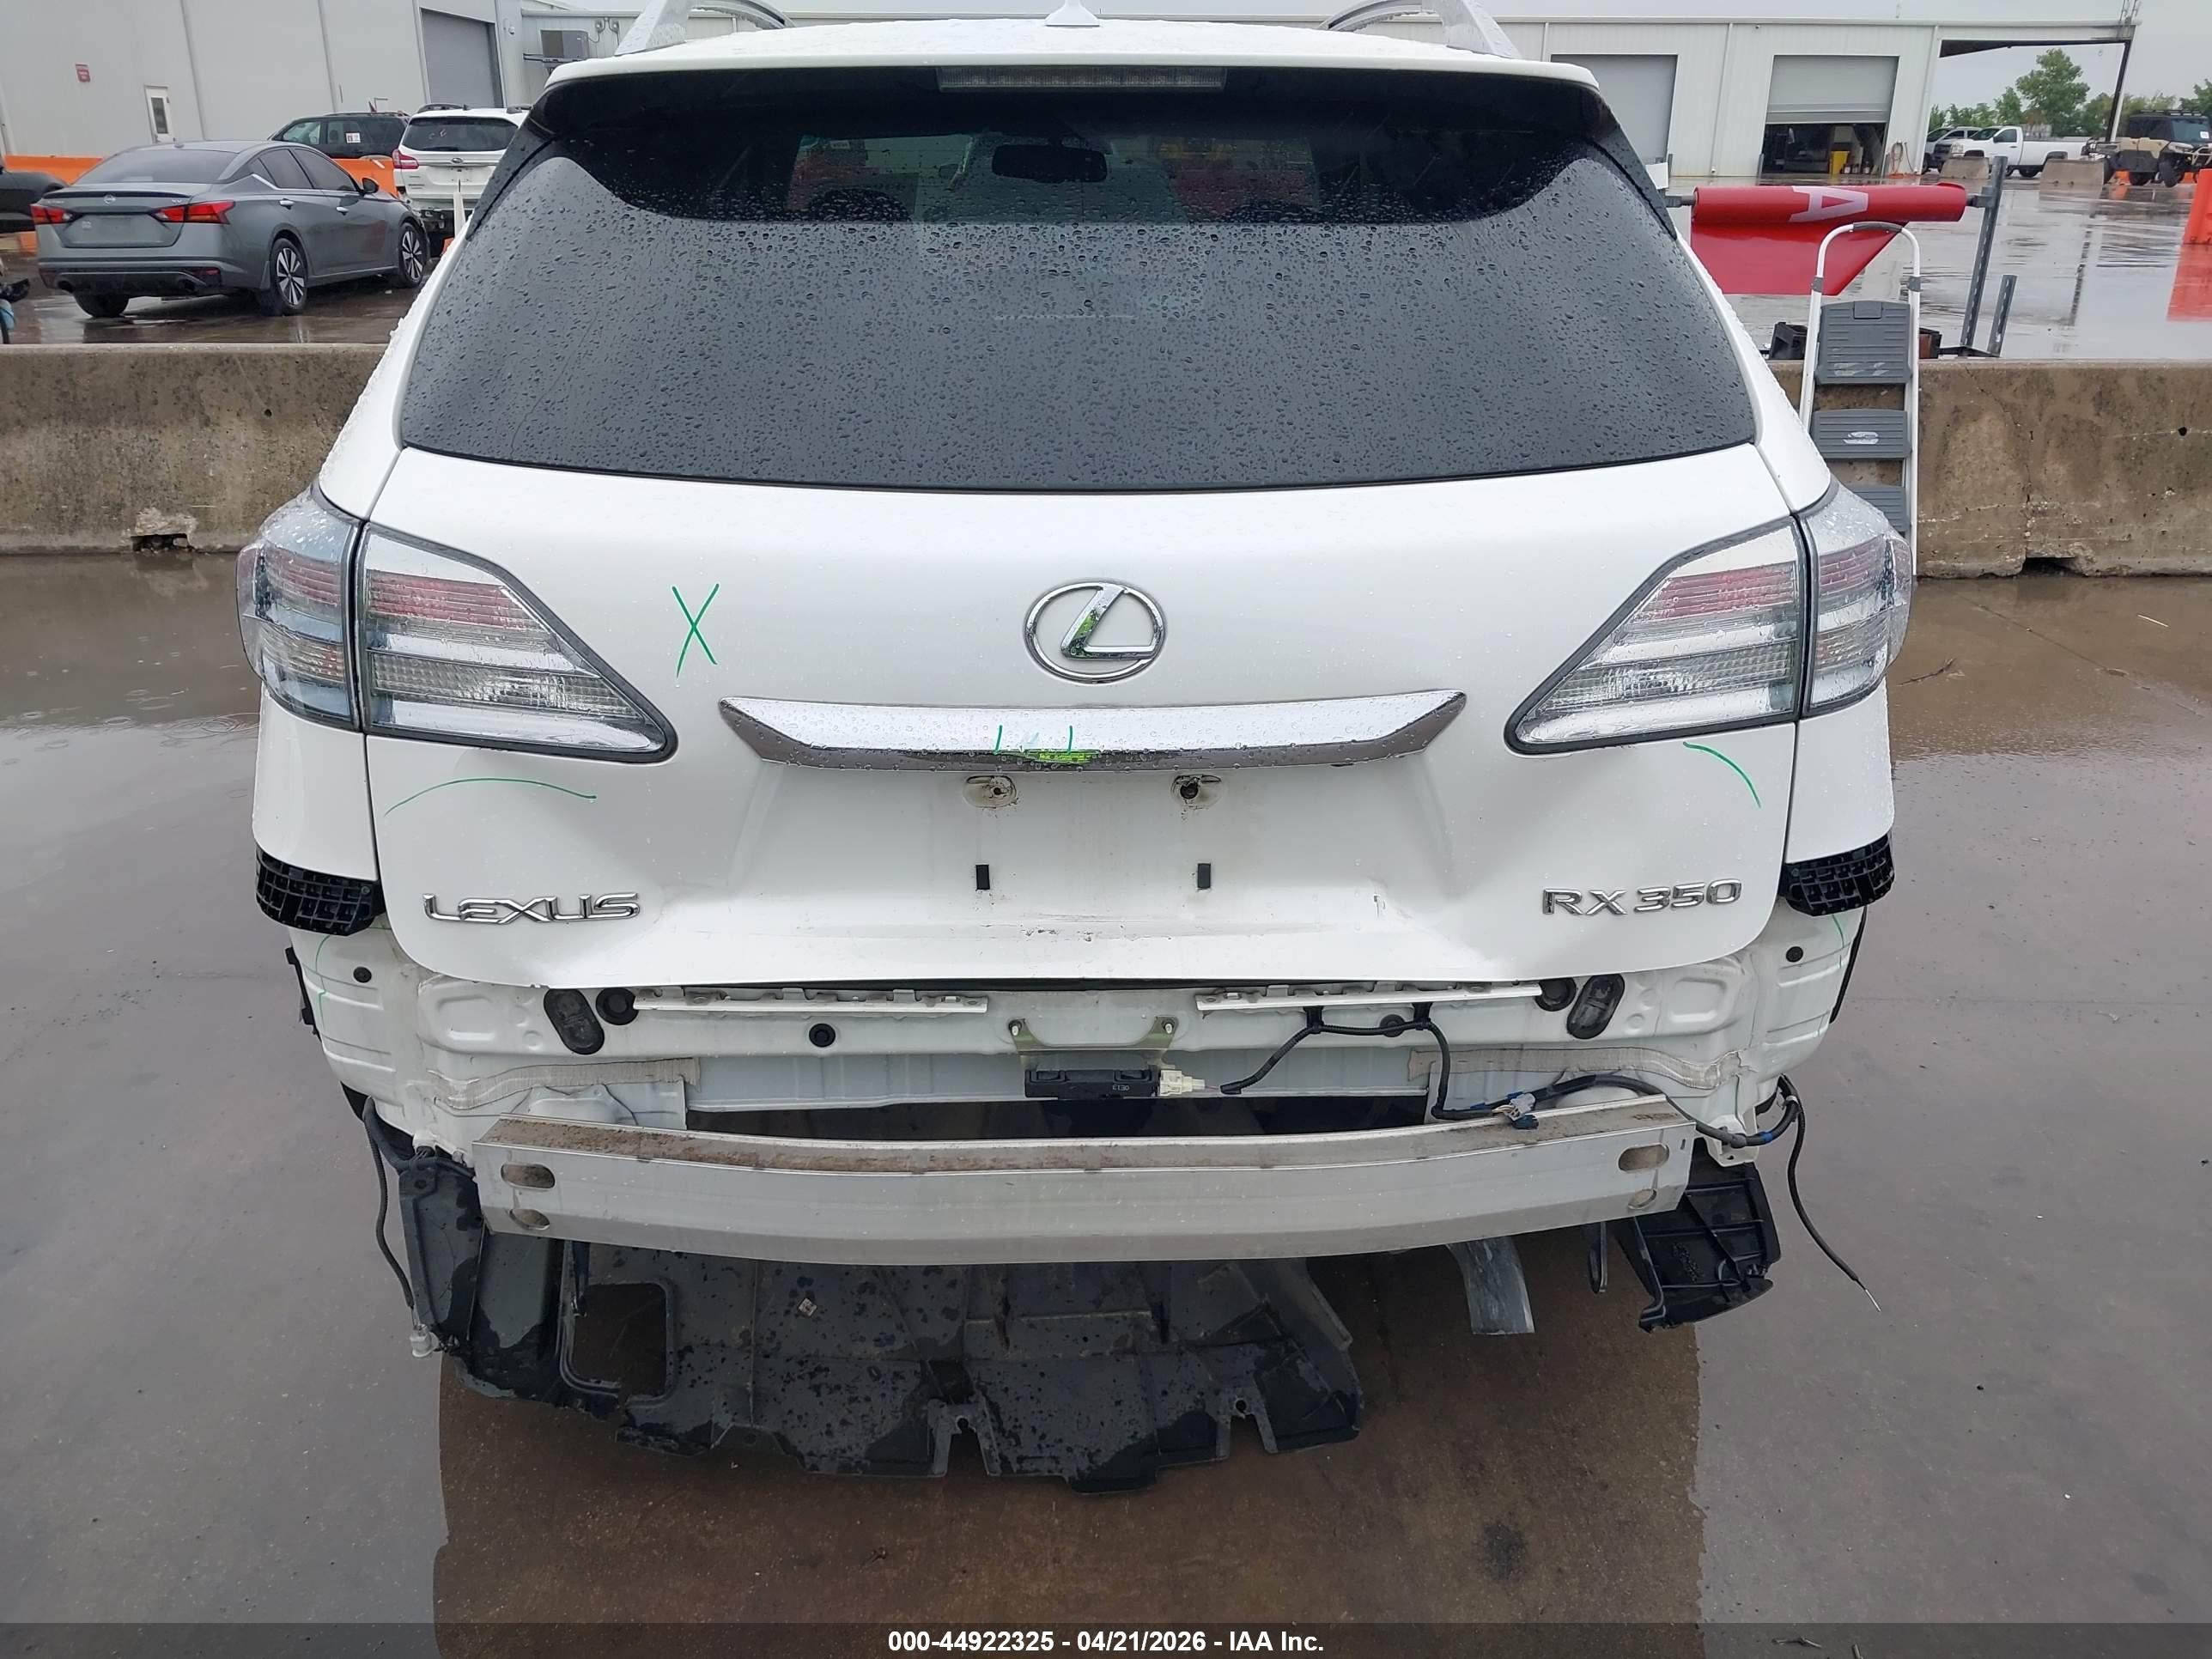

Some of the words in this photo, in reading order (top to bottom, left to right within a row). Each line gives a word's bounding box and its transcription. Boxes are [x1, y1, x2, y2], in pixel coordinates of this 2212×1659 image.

[1789, 185, 1869, 222] A
[422, 892, 641, 924] LEXUS
[1542, 888, 1628, 915] RX
[1633, 878, 1742, 912] 350
